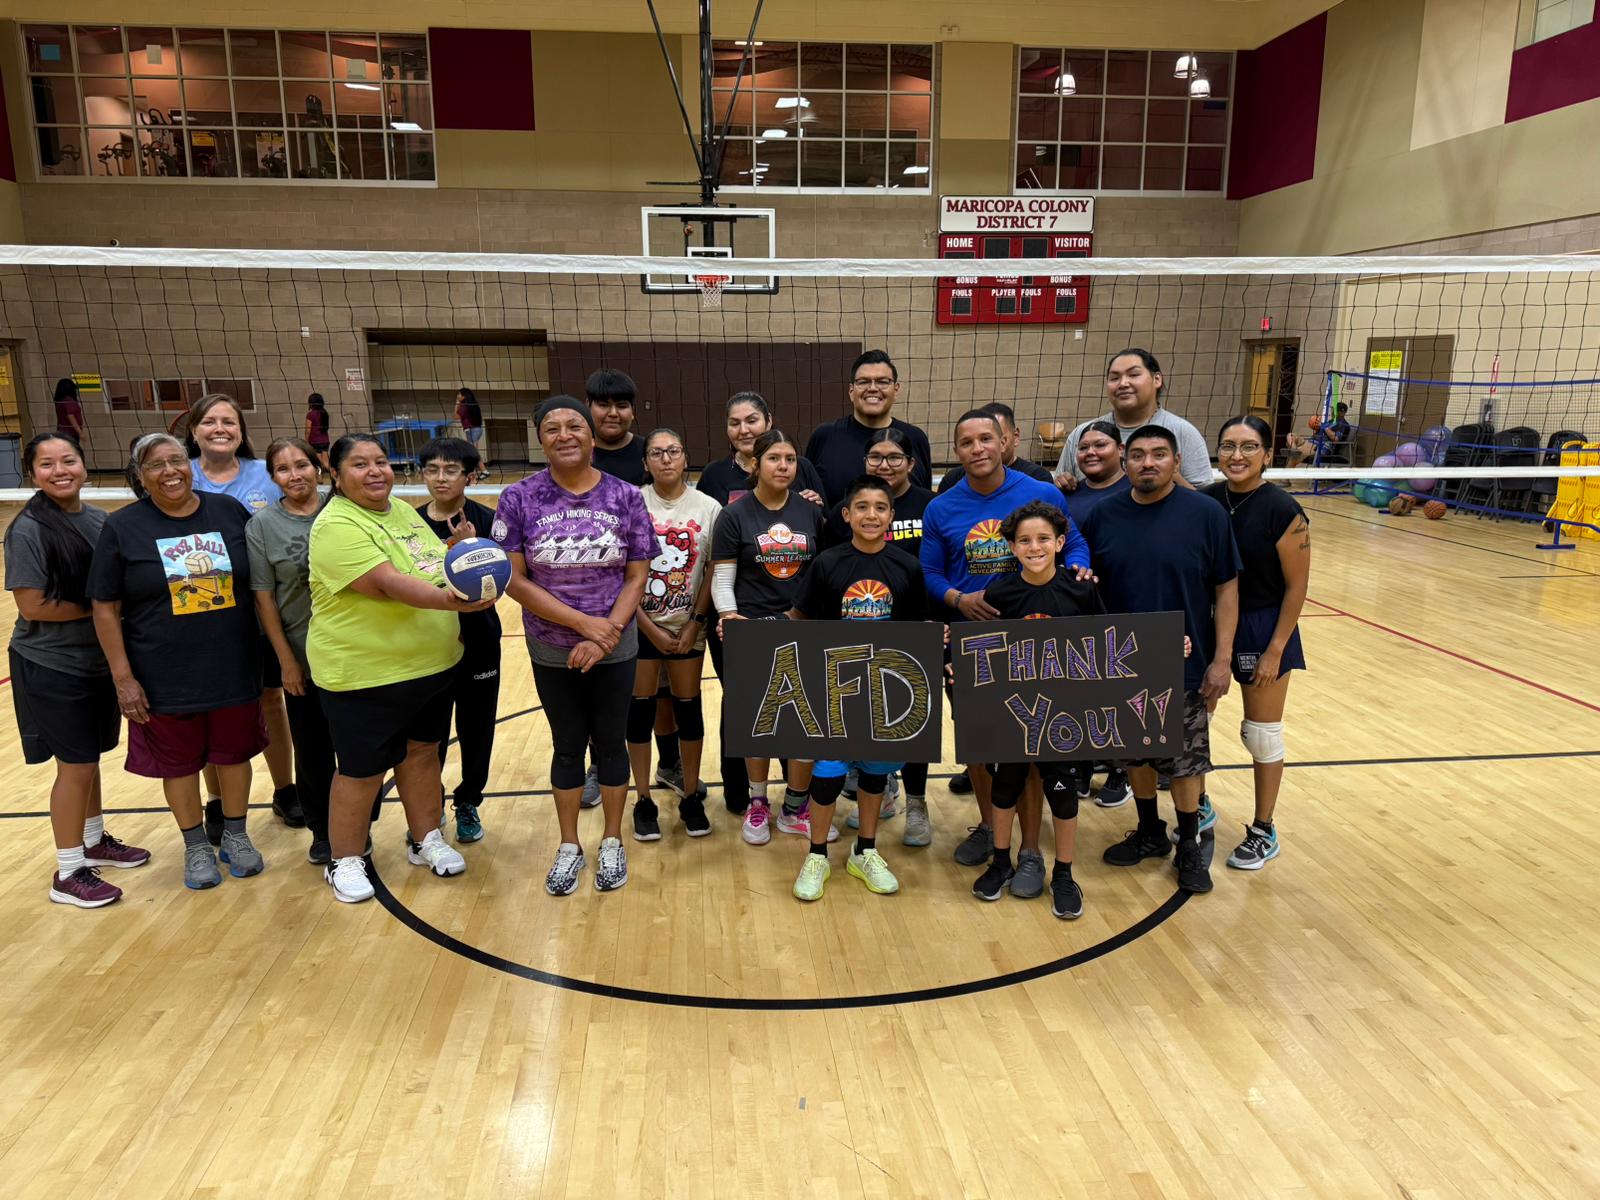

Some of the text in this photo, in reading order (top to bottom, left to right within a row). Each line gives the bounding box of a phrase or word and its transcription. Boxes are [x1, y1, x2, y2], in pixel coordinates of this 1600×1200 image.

[946, 199, 1090, 213] MARICOPA COLONY
[976, 215, 1058, 229] DISTRICT 7
[946, 237, 974, 248] HOME
[1054, 237, 1090, 248] VISITOR
[956, 276, 978, 284] BONUS
[1050, 275, 1072, 284] BONUS
[951, 288, 973, 297] FOULS
[991, 288, 1042, 297] PLAYER FOULS
[1056, 287, 1077, 296] FOULS
[536, 508, 620, 528] FAMILY HIKING SERIES
[193, 533, 226, 557] BALL
[755, 554, 785, 563] SUMMER
[960, 626, 1139, 687] THANK
[473, 669, 497, 680] adidas
[751, 641, 932, 742] AFD
